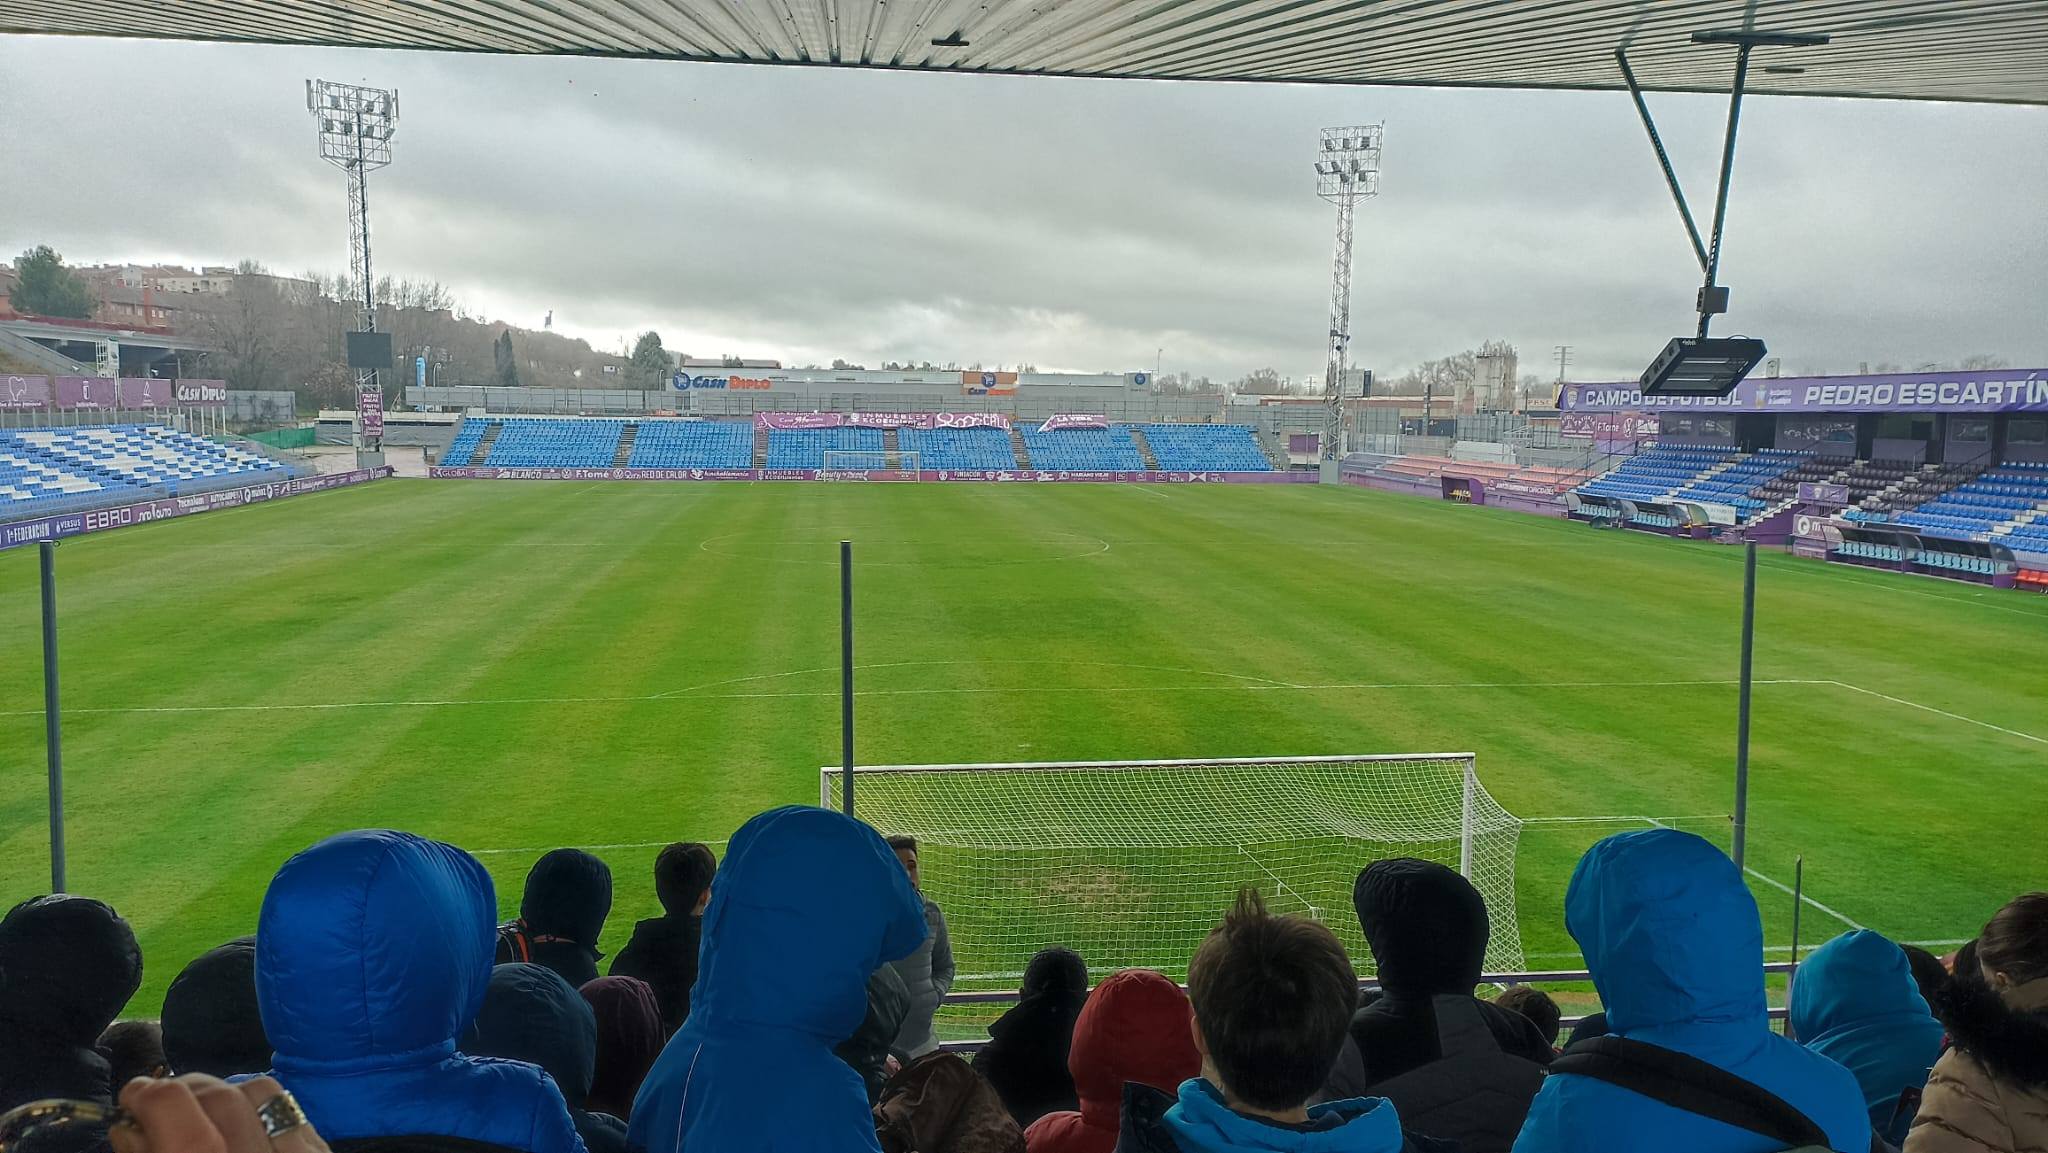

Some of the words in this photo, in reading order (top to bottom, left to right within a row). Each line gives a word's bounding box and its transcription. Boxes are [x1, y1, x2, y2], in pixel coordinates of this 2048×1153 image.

[692, 376, 727, 389] CASH
[729, 376, 771, 390] DIPLO
[178, 385, 200, 401] CASH
[201, 384, 226, 401] DIPLO
[1585, 391, 1642, 406] CAMPO
[1803, 384, 1895, 406] PEDRO
[511, 469, 542, 479] BLANCO
[576, 469, 609, 479] F.Tomé
[641, 470, 655, 479] RED
[656, 470, 665, 479] DE
[665, 470, 687, 479] CALOR
[60, 519, 81, 528] VERSUS
[86, 508, 132, 530] EBRO
